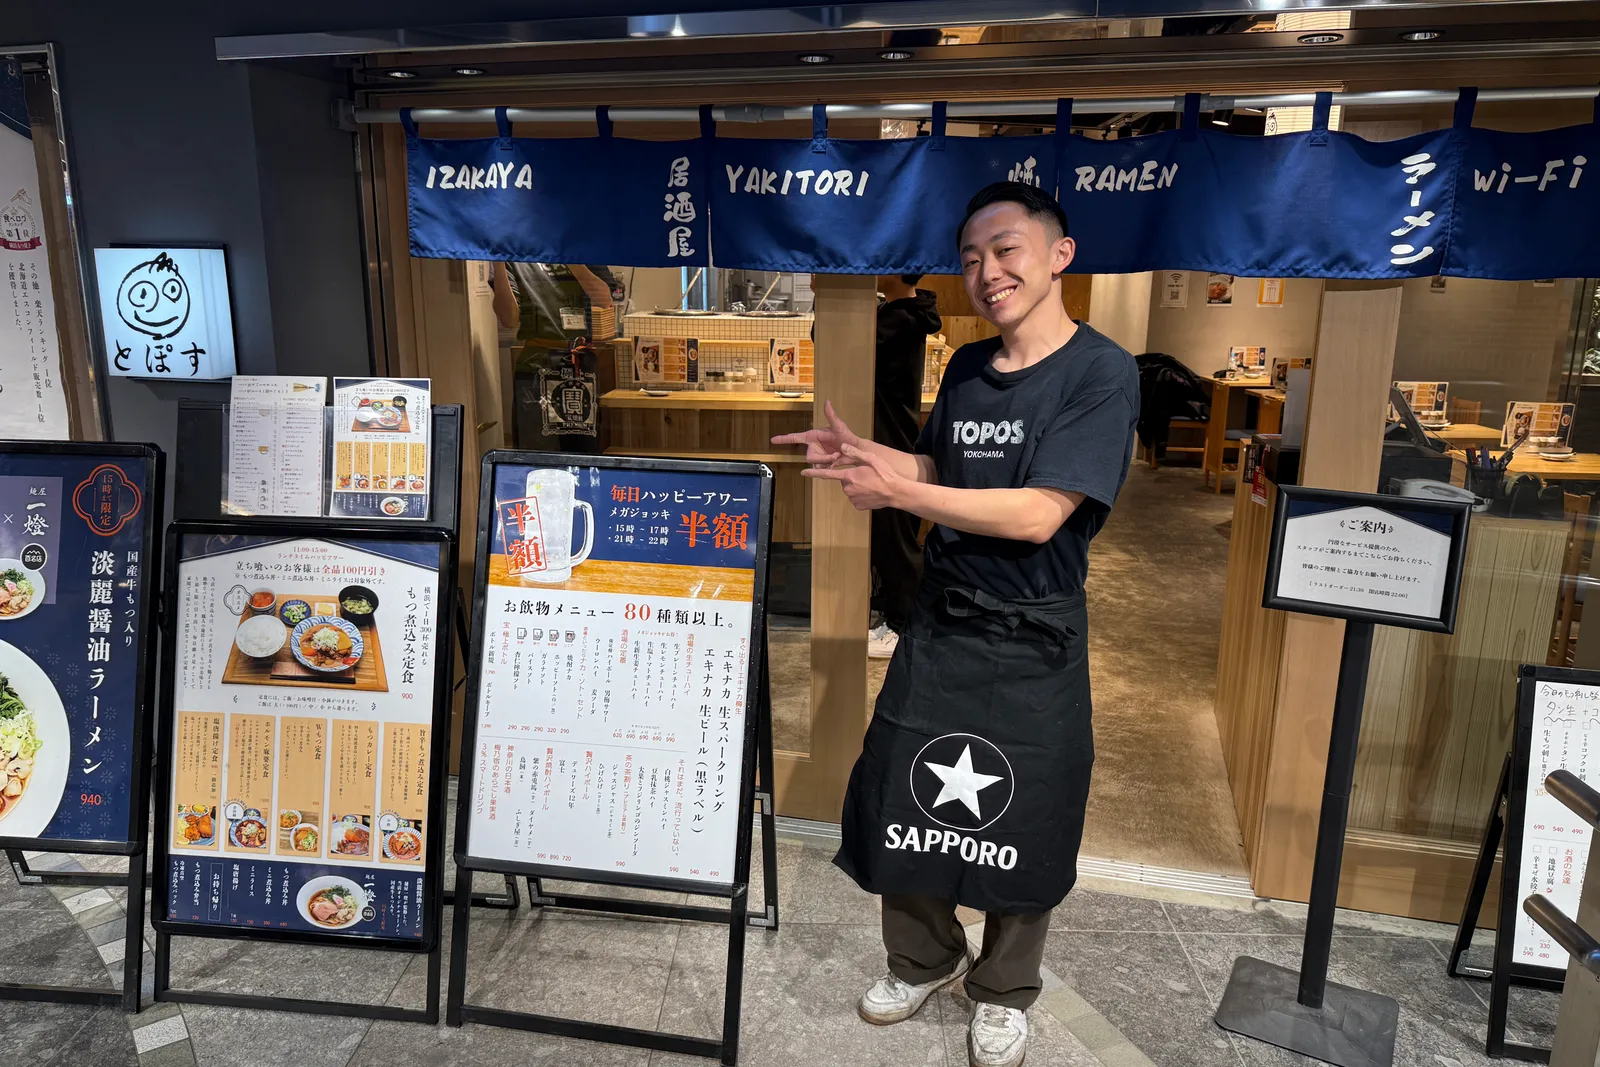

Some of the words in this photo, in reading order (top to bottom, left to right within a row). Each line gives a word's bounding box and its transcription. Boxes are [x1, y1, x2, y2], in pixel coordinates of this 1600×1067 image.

[426, 161, 533, 190] IZAKAYA
[725, 163, 870, 197] YAKITORI
[1074, 160, 1179, 192] RAMEN
[663, 156, 696, 258] 居酒屋
[1390, 152, 1437, 265] ラーメン
[6, 227, 30, 240] 第1位
[114, 339, 206, 376] とぽす
[952, 419, 1025, 445] TOPOS
[963, 450, 1005, 459] YOKOHAMA
[28, 486, 47, 496] 麺屋
[99, 474, 113, 527] 15時まで限定
[610, 484, 748, 506] 毎日ハッピーアワー
[21, 501, 50, 536] 一燈
[609, 506, 671, 520] メガジョッキ
[1347, 519, 1388, 535] ご案内
[505, 502, 543, 572] 半額
[648, 537, 669, 546] 22時
[650, 526, 670, 535] 17時
[675, 510, 750, 551] 半額
[1327, 538, 1401, 553] 円滑なサービス提供のため、
[24, 555, 43, 563] 百名店
[1296, 545, 1432, 566] スタッフがご案内するまでこちらでお待ちください。
[1301, 563, 1421, 584] 皆様のご理解とご協力をお願い申し上げます。
[123, 550, 139, 647] 国産牛もつ入り
[503, 599, 615, 618] お飲物メニュー
[624, 602, 651, 621] 80
[656, 608, 733, 629] 種類以上。
[401, 586, 418, 684] もつ煮込み定食
[419, 586, 432, 666] 横浜で1日300杯売れる
[83, 550, 115, 775] 淡麗醤油ラーメン
[527, 652, 535, 685] バイスソト
[540, 652, 548, 685] ガラナソト
[565, 654, 574, 681] 焼酎ナカ
[592, 638, 601, 677] ウーロンハイ
[658, 641, 668, 702] 生レモンチューハイ
[684, 633, 695, 696] 酒場の生チューハイ
[702, 647, 715, 698] エキナカ
[721, 649, 734, 699] エキナカ
[670, 642, 680, 709] 生プレーンチューハイ
[401, 692, 413, 700] 900
[484, 682, 493, 718] ボトルキープ
[590, 688, 598, 716] 麦ソーダ
[365, 726, 374, 778] もつカレー定食
[713, 705, 731, 813] 生スパークリング
[503, 745, 514, 794] 神奈川の日本酒
[80, 793, 102, 806] 940
[884, 823, 1018, 870] SAPPORO
[248, 865, 256, 897] ミニライス
[1562, 848, 1573, 885] お酒の友達
[211, 873, 220, 911] お持ち帰り
